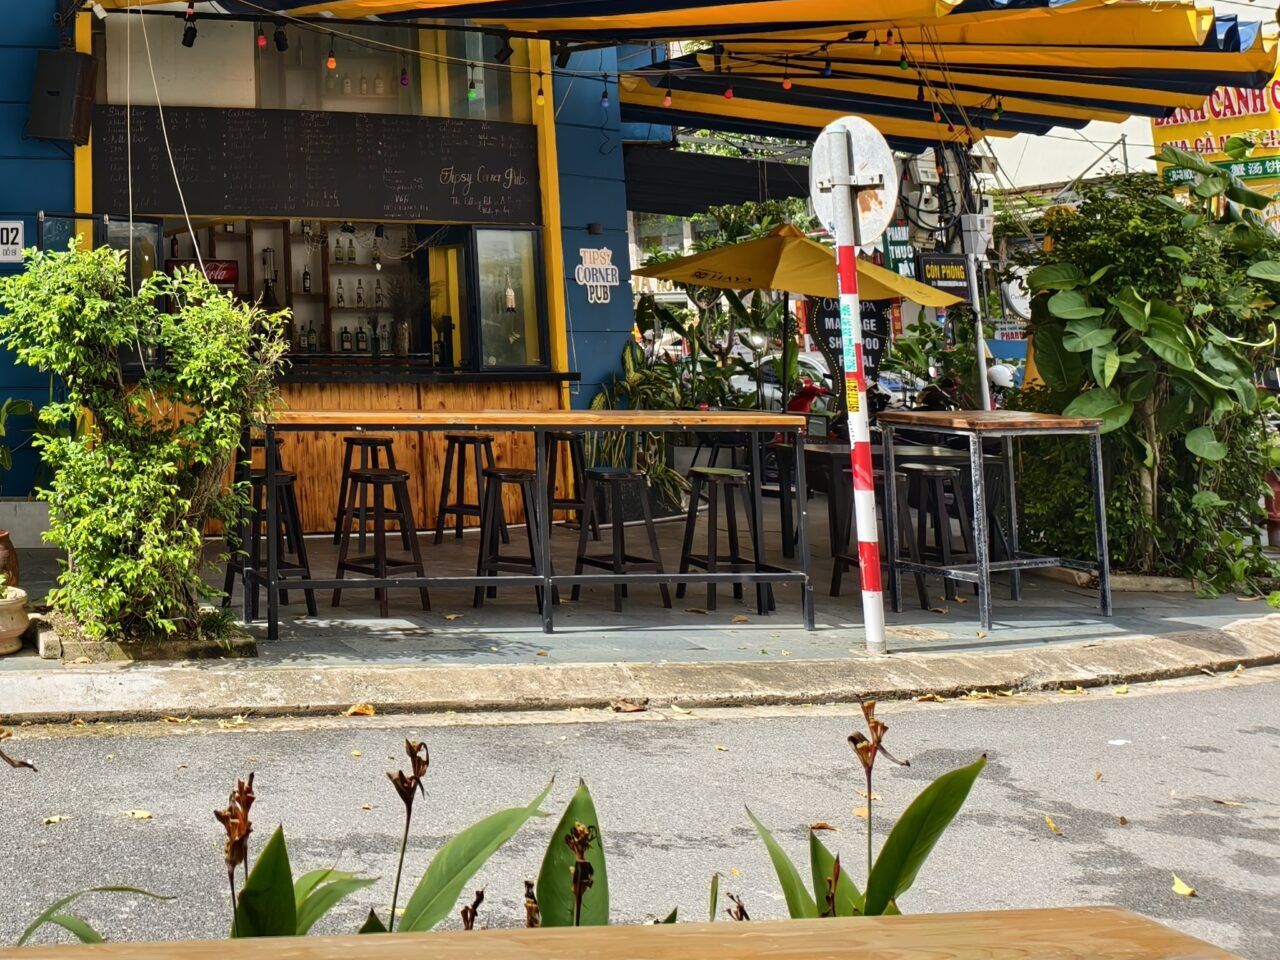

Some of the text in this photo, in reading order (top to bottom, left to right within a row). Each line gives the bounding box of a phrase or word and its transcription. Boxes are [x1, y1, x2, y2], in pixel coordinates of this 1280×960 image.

[0, 227, 20, 246] 02
[576, 266, 618, 283] CORNER
[589, 284, 609, 301] PUB
[824, 317, 877, 331] MAGE
[828, 336, 880, 350] SHOO
